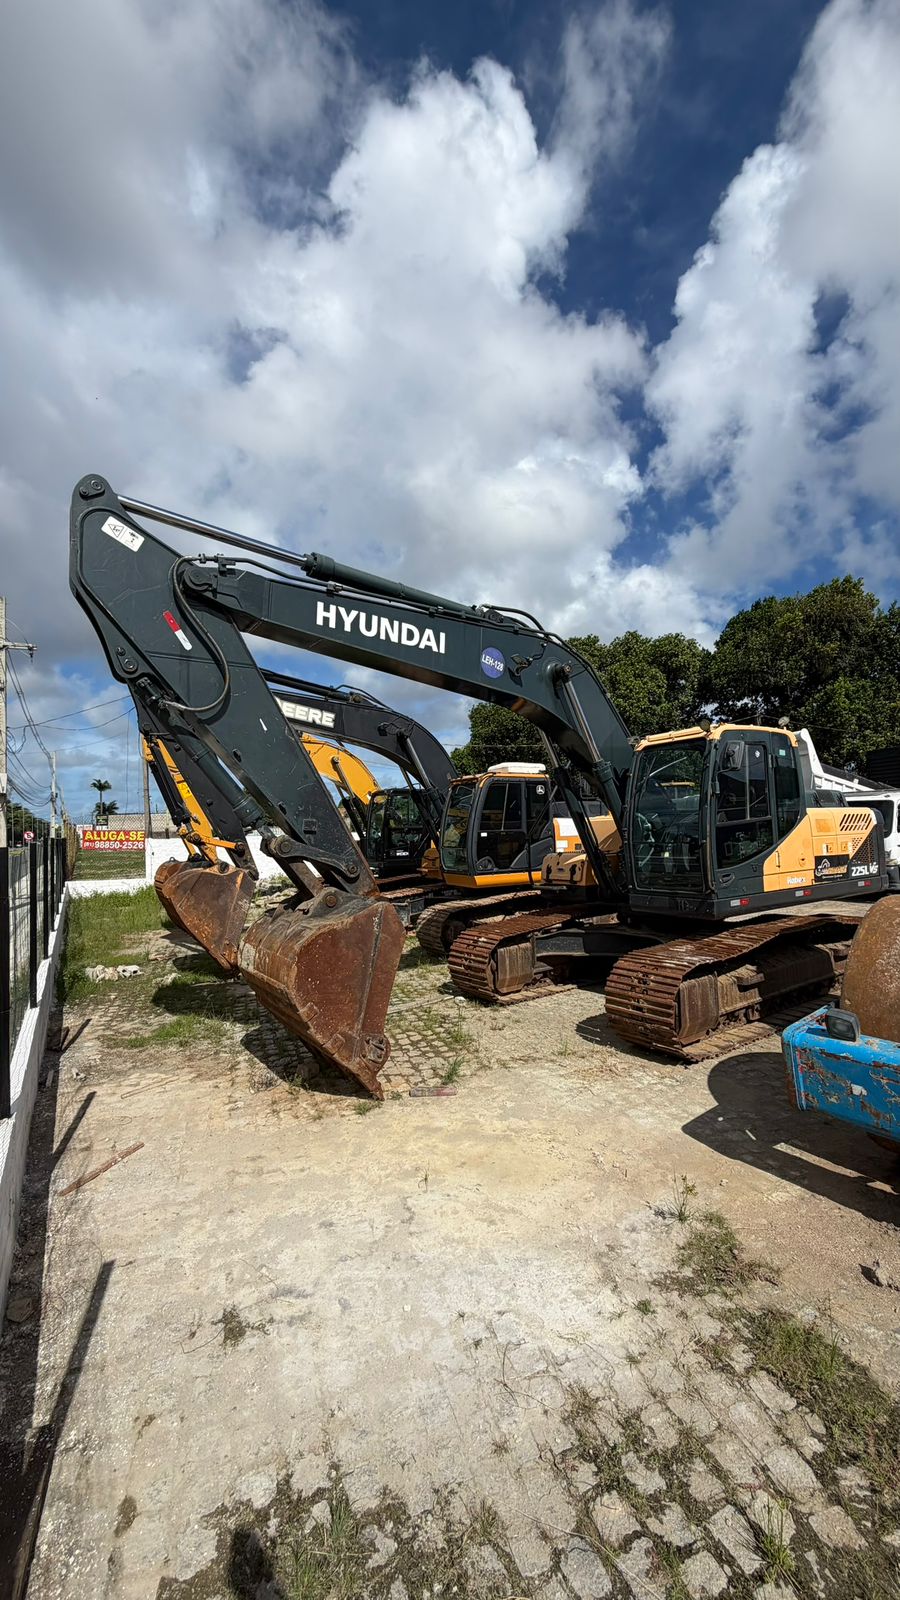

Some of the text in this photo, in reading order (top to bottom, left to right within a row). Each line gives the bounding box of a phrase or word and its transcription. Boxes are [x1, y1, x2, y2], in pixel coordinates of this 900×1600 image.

[316, 601, 446, 654] HYUNDAI
[481, 653, 504, 672] LEH-128
[274, 696, 336, 728] EERE
[85, 831, 145, 840] ALUGA-SE
